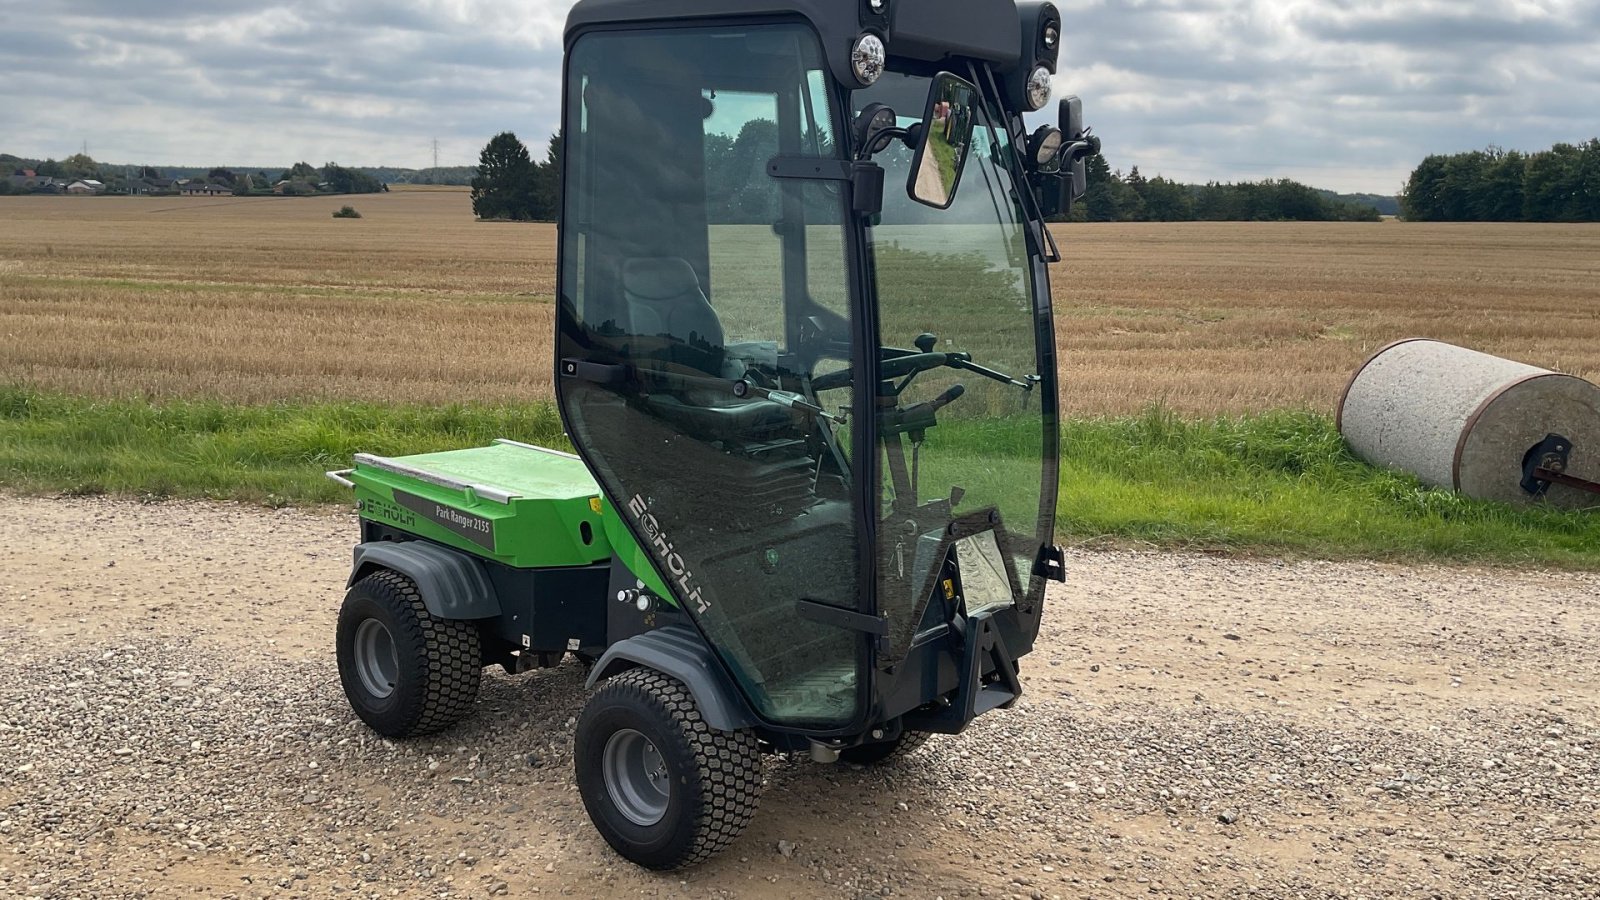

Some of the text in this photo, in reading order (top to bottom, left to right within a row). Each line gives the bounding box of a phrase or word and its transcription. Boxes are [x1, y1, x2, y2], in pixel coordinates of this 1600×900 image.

[367, 498, 415, 527] EGHOLM
[436, 505, 490, 533] Park Ranger 2155
[628, 493, 712, 614] EGHOLM
